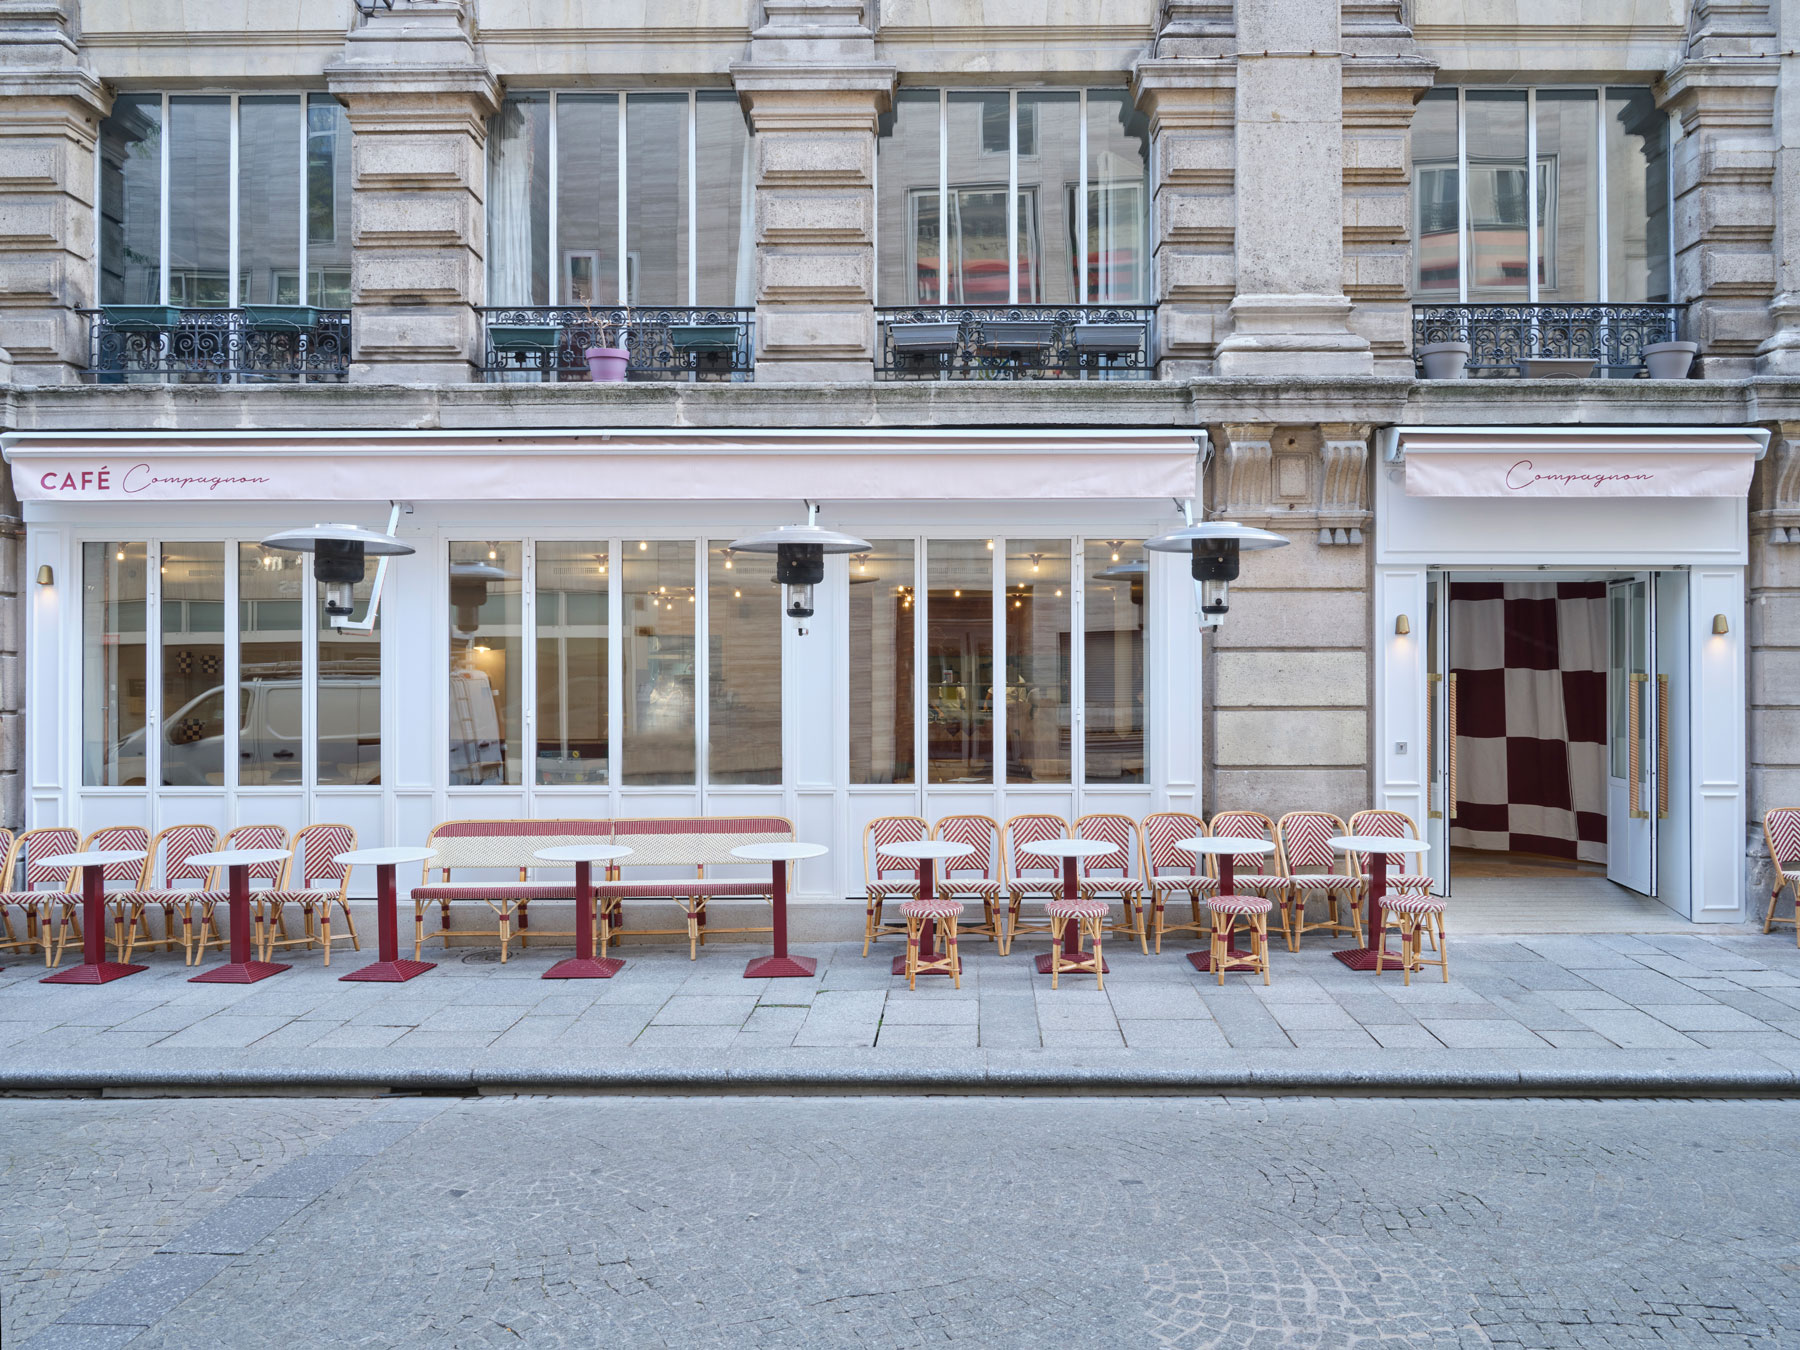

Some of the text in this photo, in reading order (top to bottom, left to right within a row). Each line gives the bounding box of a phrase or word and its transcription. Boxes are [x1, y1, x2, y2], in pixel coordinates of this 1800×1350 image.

[40, 463, 270, 493] CAFÉ Compagnon
[1505, 460, 1654, 489] Compagnon
